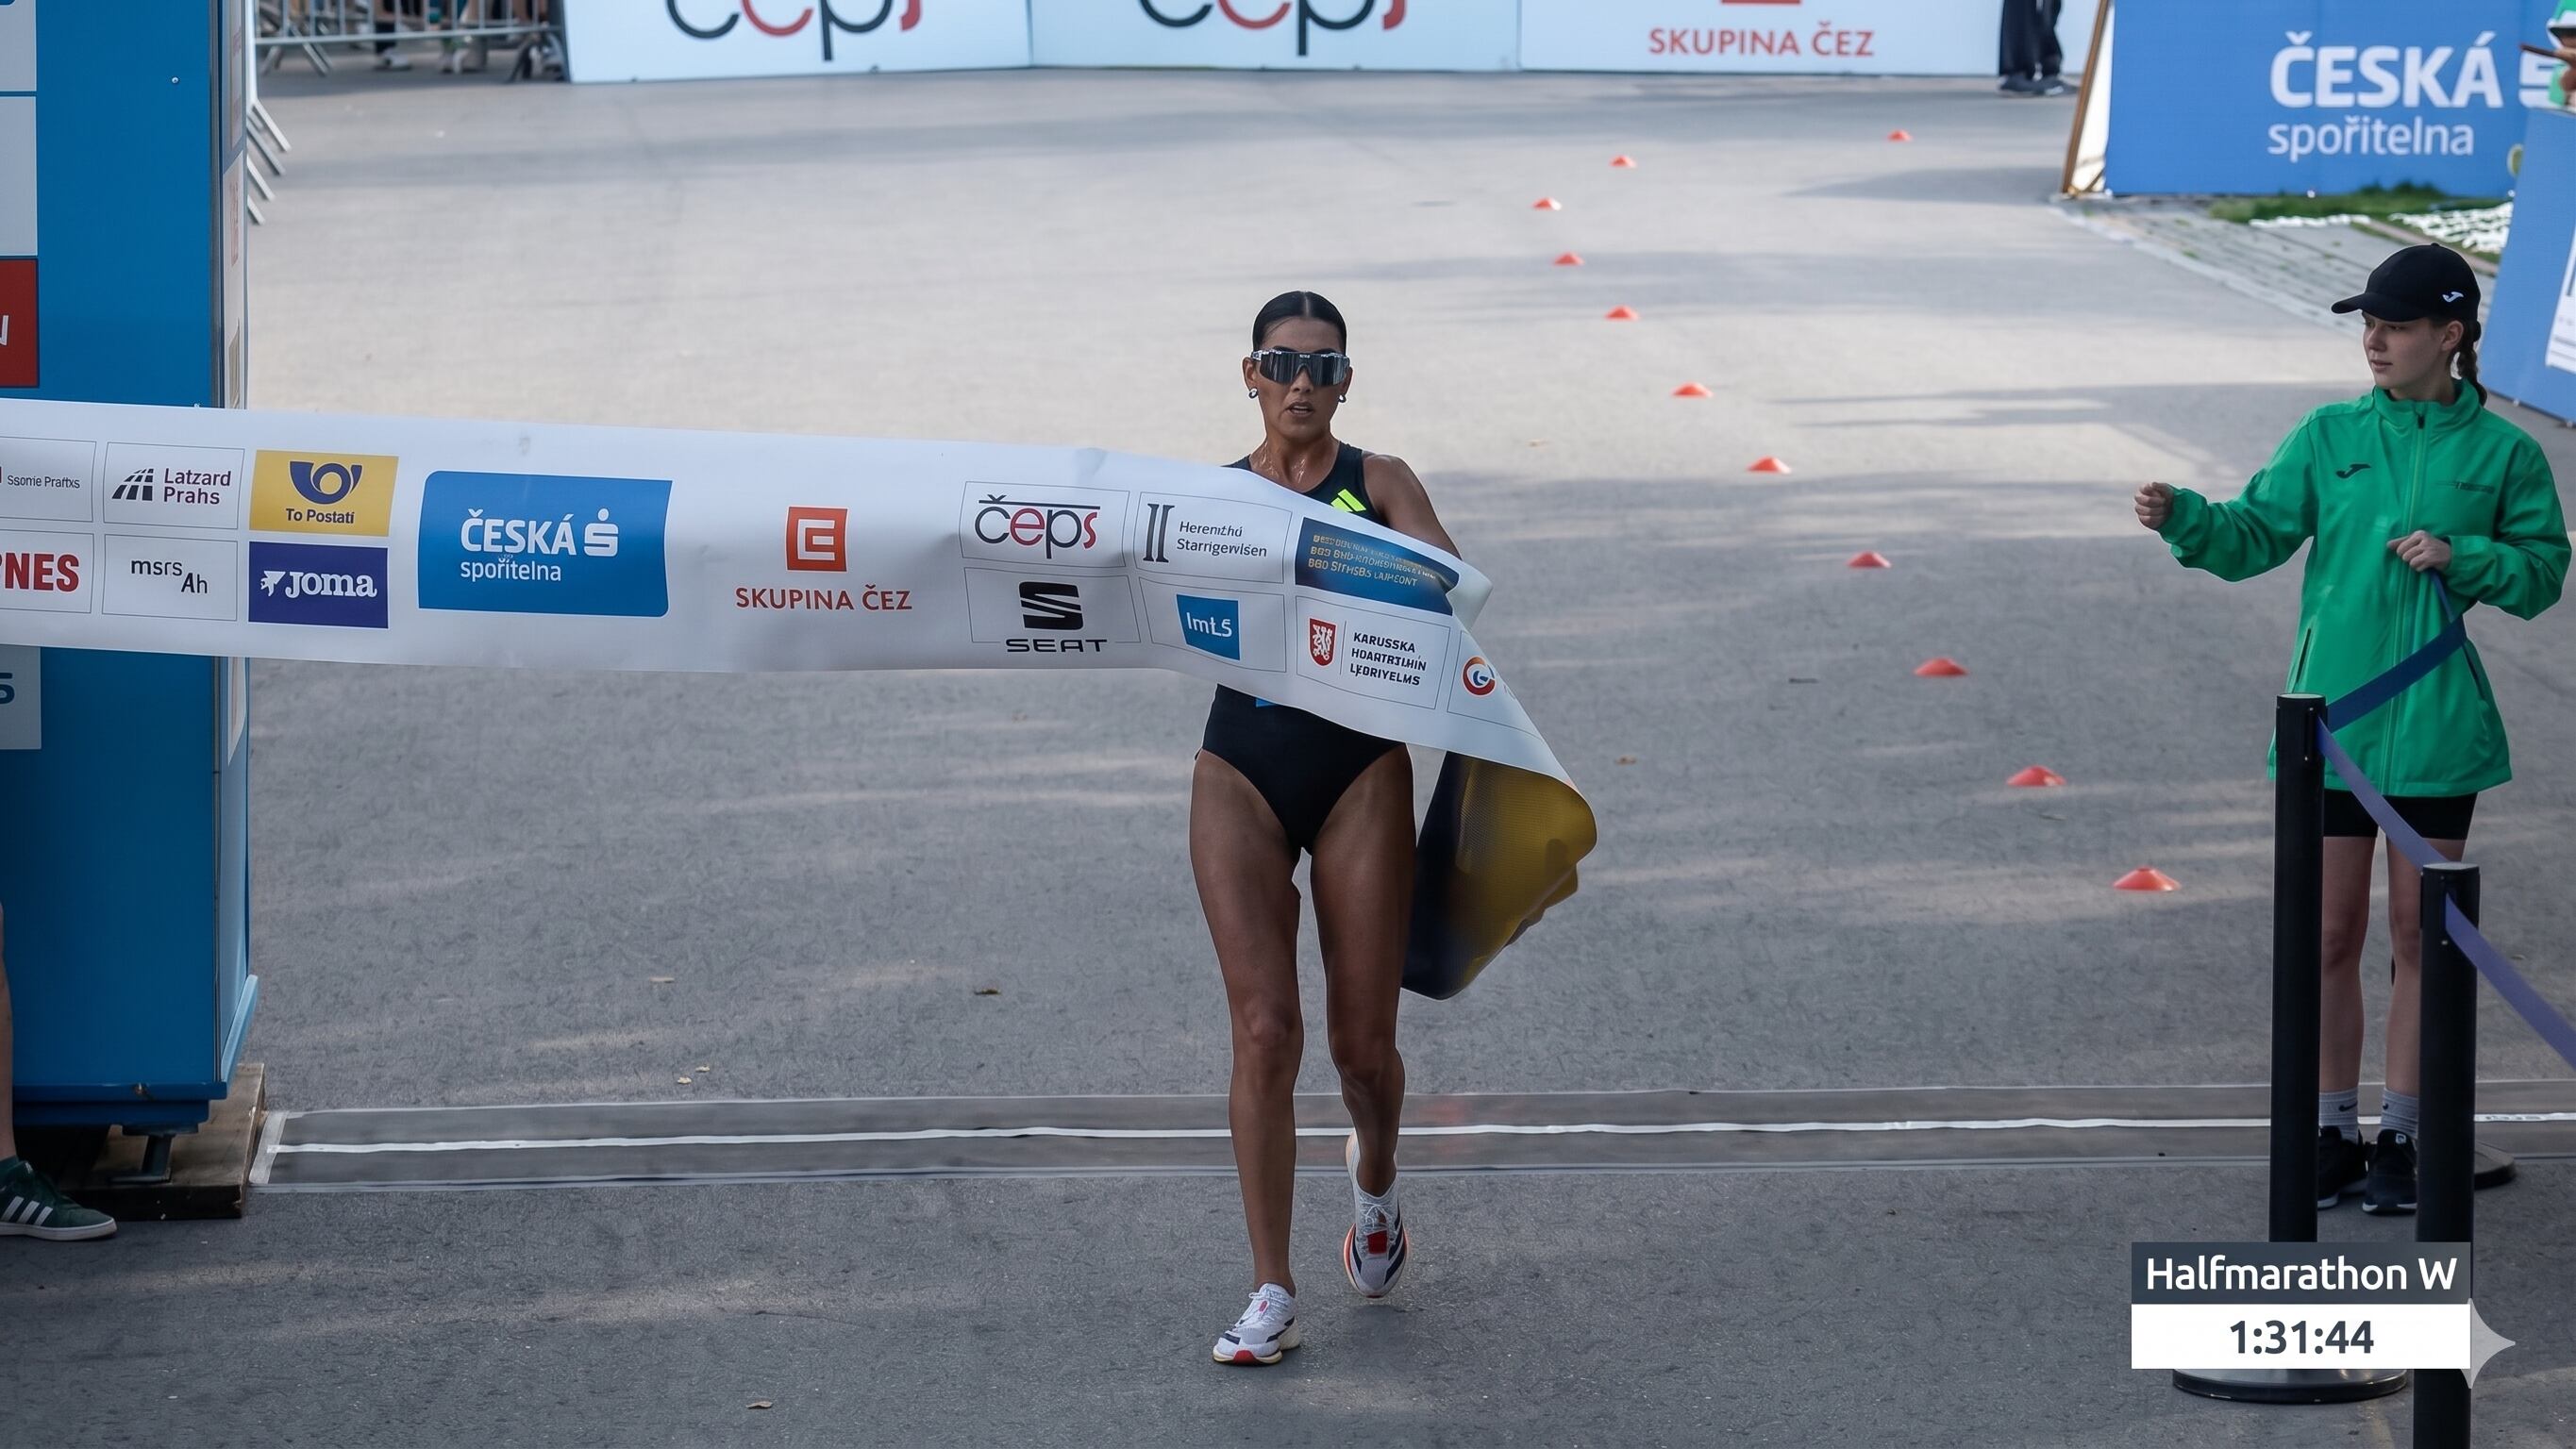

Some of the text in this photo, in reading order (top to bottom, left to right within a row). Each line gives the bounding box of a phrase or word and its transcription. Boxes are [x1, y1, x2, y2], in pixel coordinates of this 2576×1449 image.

[1648, 21, 1874, 56] SKUPINA ČEZ
[2269, 31, 2503, 108] ČESKÁ
[2267, 115, 2474, 162] spořitelna
[164, 468, 232, 486] Latzard
[163, 487, 220, 505] Prahs
[286, 508, 302, 522] To
[460, 508, 577, 556] ČESKÁ
[0, 553, 79, 592] NES
[131, 560, 182, 576] msrs
[181, 573, 208, 594] Ah
[736, 584, 912, 610] SKUPINA ČEZ
[1006, 639, 1107, 653] SEAT
[1353, 632, 1415, 653] KARUSSKA
